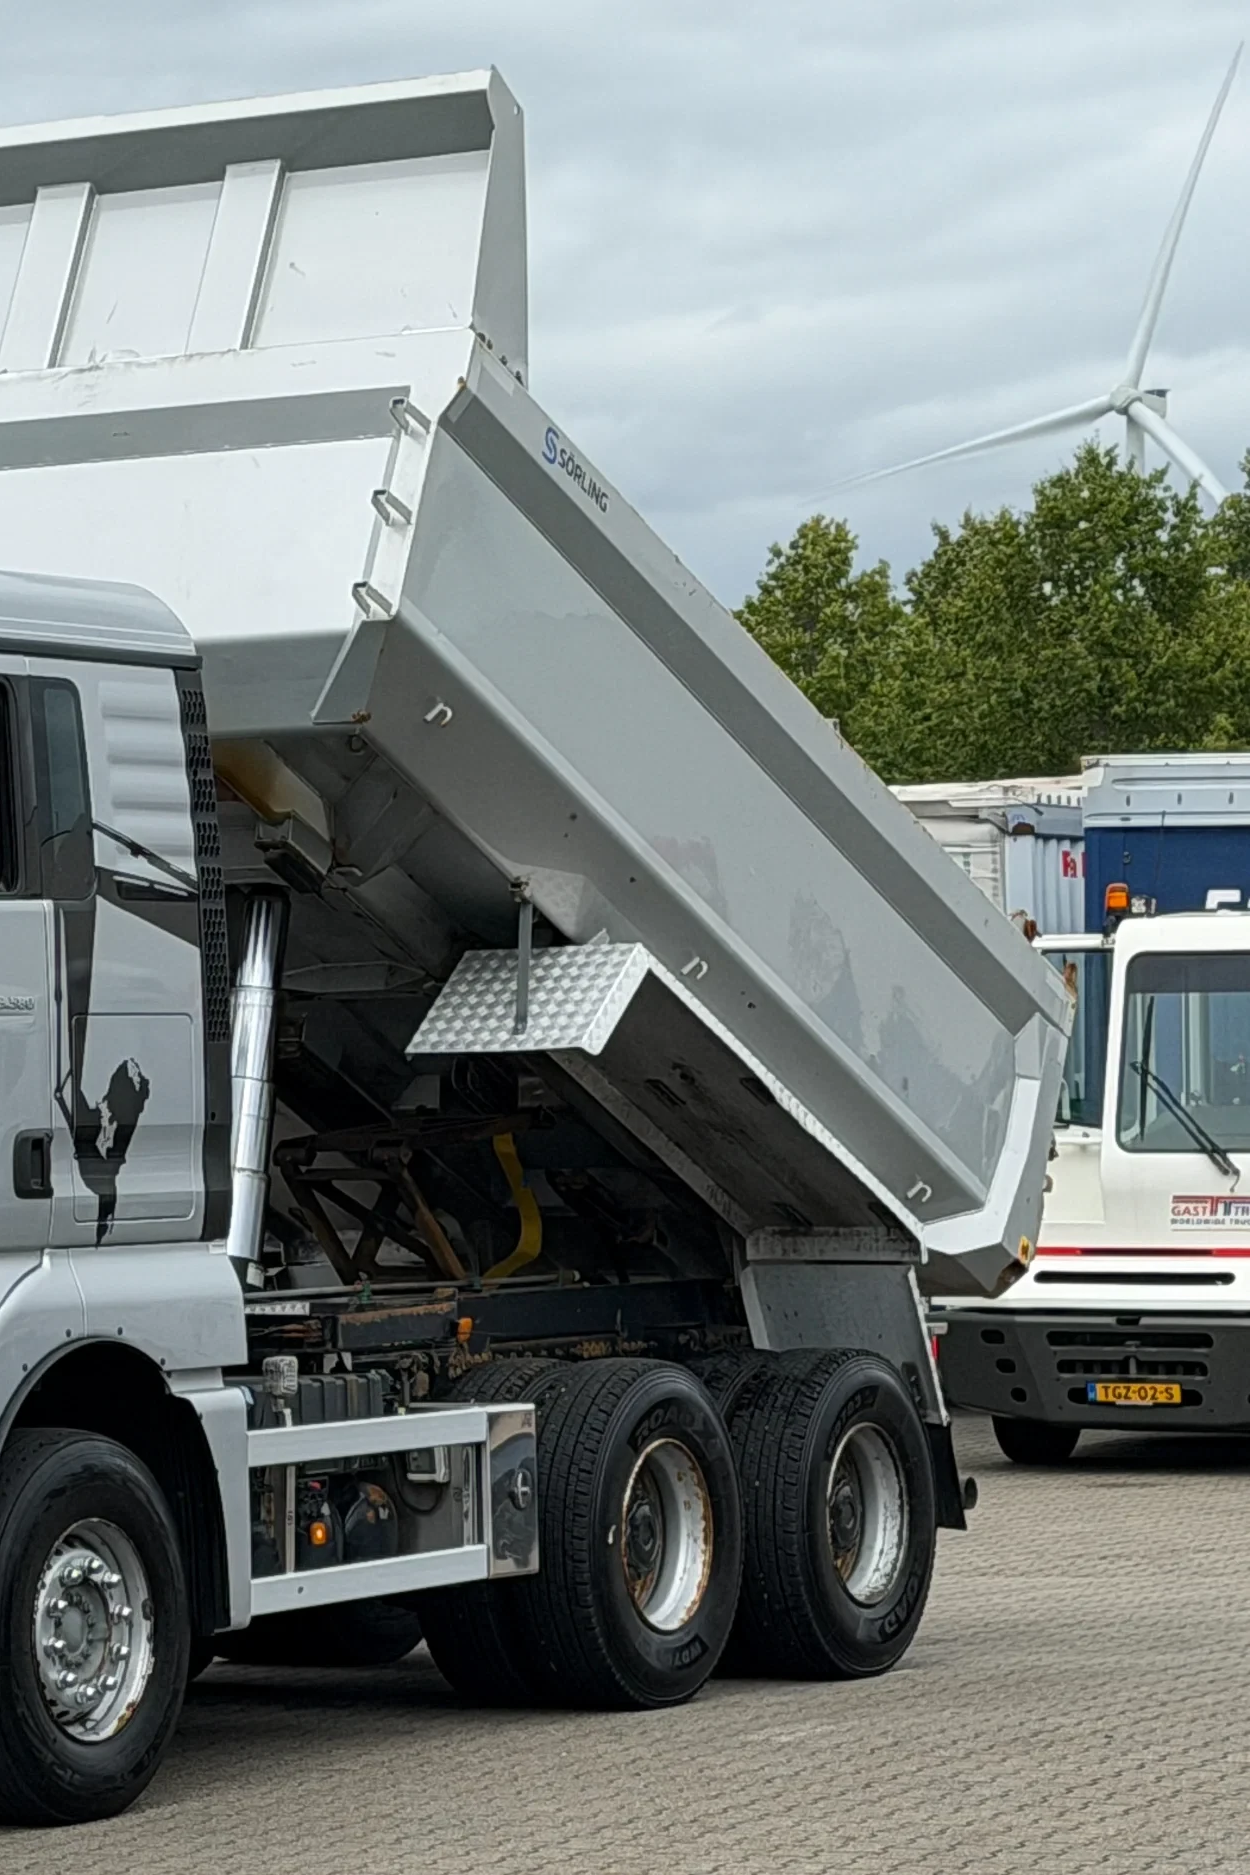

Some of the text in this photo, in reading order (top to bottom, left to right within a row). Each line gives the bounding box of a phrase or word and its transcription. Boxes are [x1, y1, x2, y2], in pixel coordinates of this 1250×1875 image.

[558, 448, 608, 513] SÖRLING
[1171, 1206, 1208, 1216] GAST
[1101, 1386, 1175, 1401] TGZ-02-S
